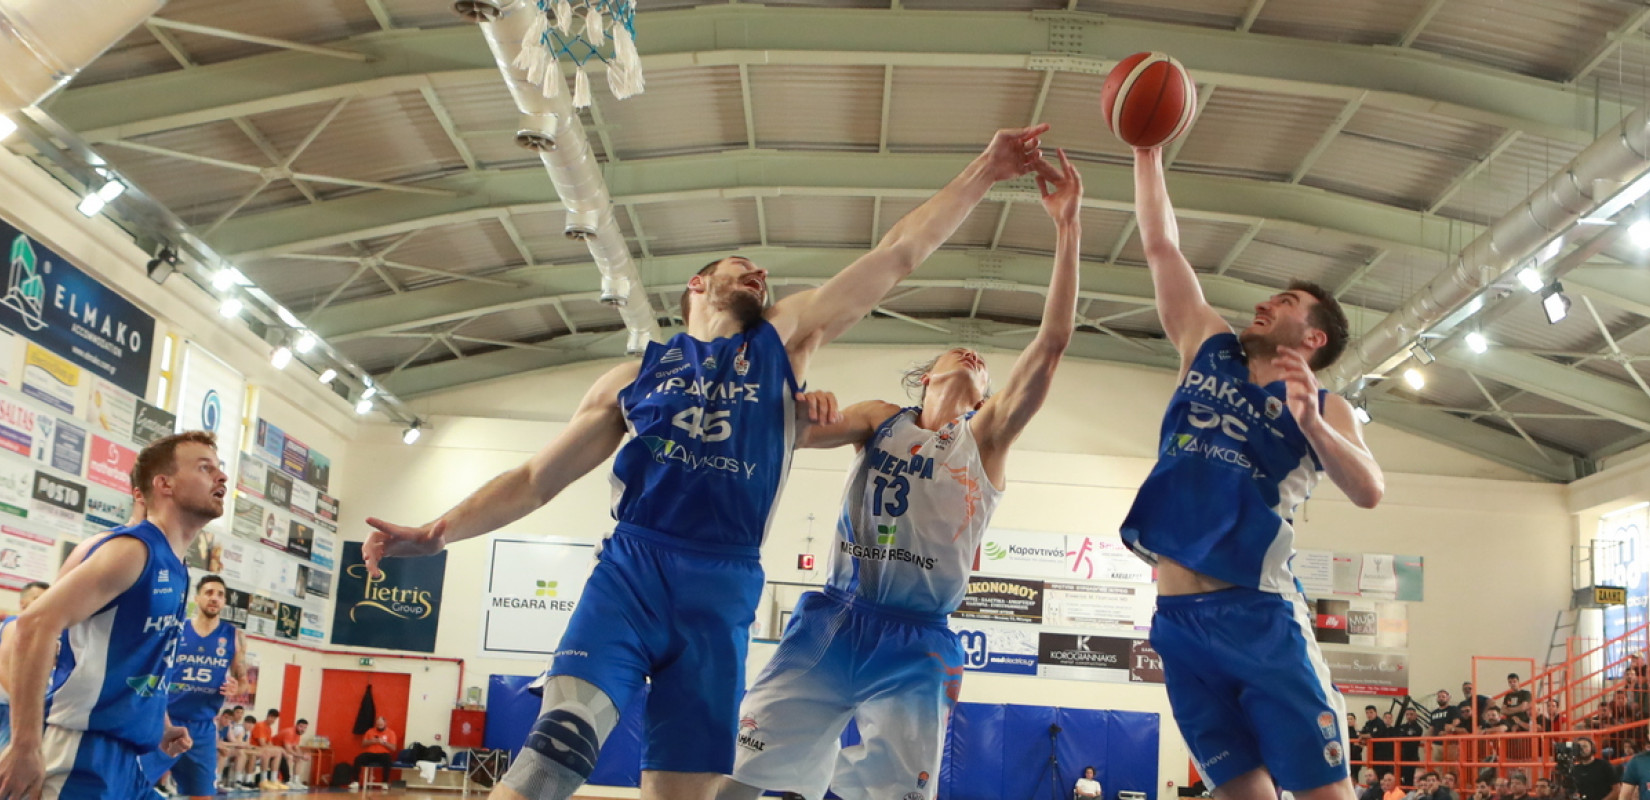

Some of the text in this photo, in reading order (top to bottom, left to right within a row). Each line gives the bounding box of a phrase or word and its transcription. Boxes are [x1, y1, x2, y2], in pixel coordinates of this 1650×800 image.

[53, 285, 141, 353] ELMAKO
[656, 363, 691, 378] GIVOVA
[672, 406, 732, 442] 45
[873, 475, 910, 517] 13
[841, 541, 887, 561] MEGARA
[1009, 544, 1064, 558] Καραντινός
[966, 581, 1038, 600] ΙΚΟΝΟΜΟΥ
[392, 602, 423, 615] Group
[492, 597, 576, 612] MEGARA RES
[182, 667, 212, 683] 15
